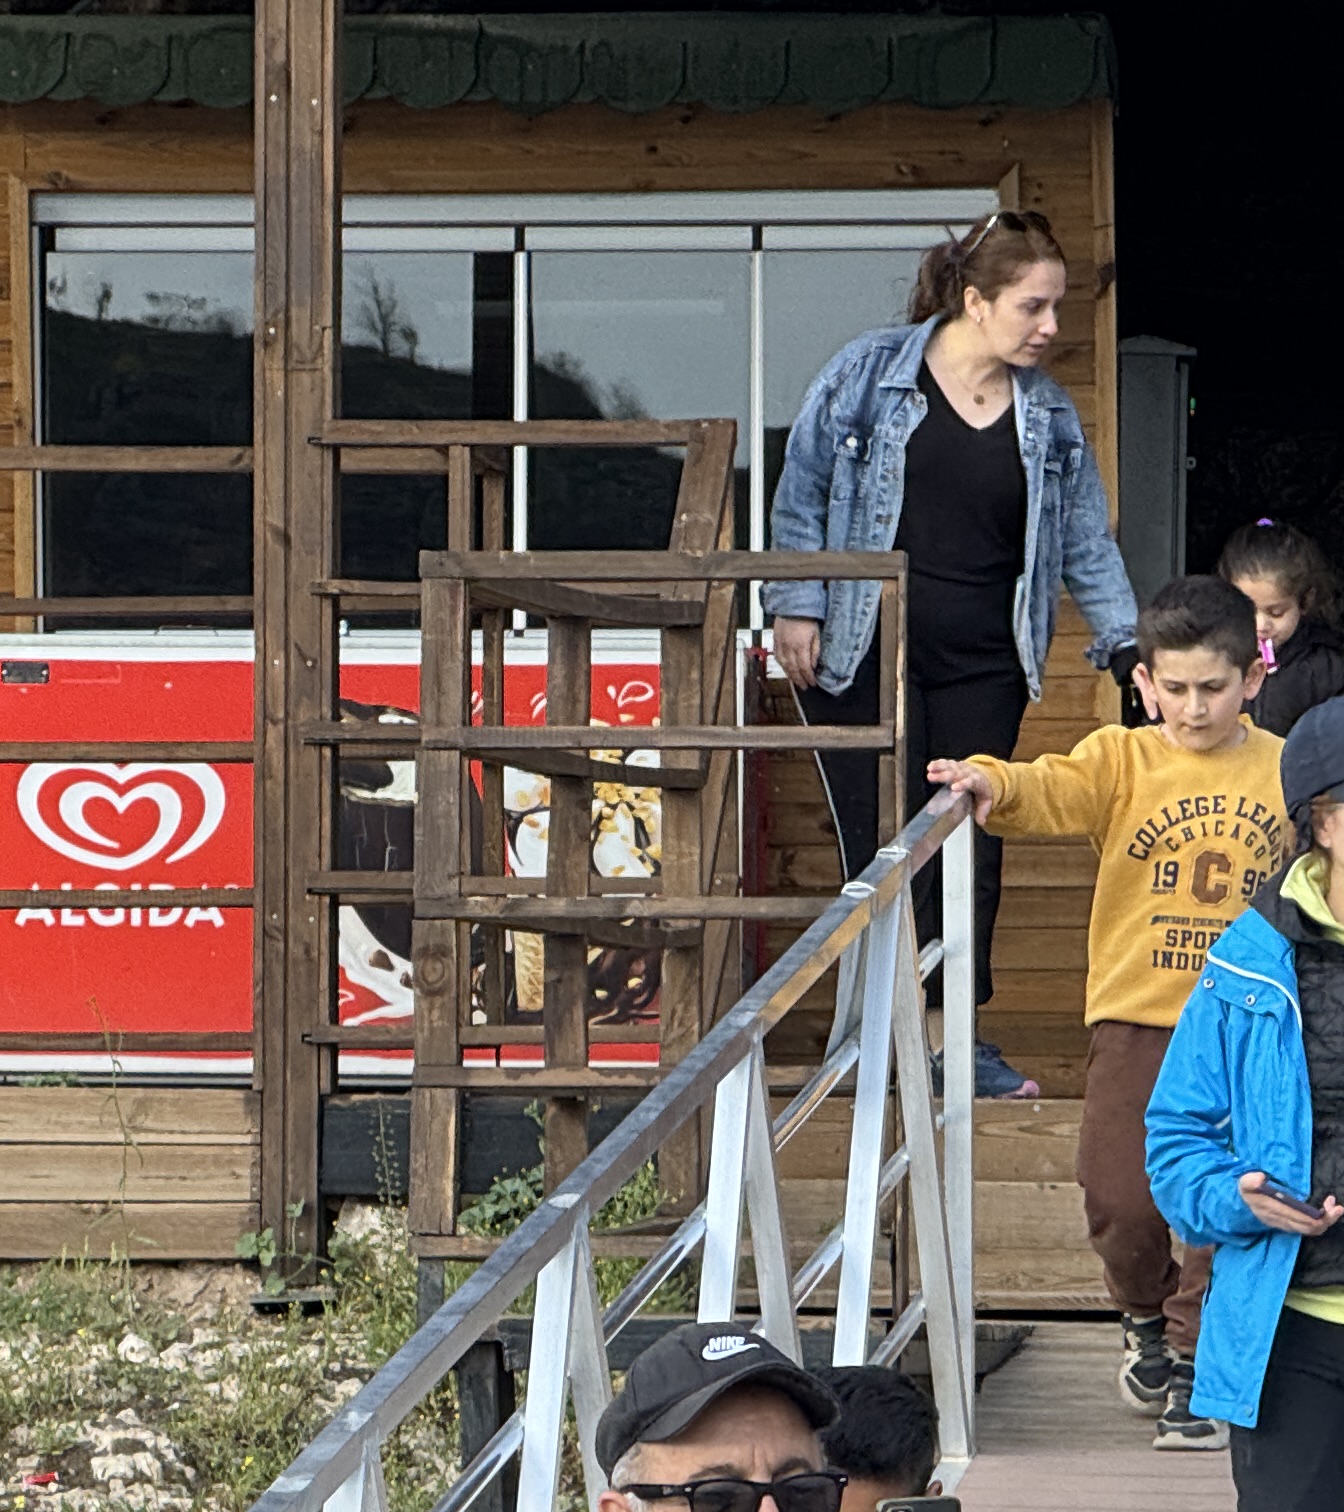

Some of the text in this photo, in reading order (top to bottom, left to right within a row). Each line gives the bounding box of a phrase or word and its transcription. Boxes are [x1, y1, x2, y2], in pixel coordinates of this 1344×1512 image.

[1127, 794, 1227, 861] COLLEGE
[1164, 820, 1267, 860] CHICAGO
[1152, 861, 1180, 888] 19
[1191, 850, 1233, 904] C
[15, 882, 225, 928] ALGIDA
[1152, 949, 1207, 971] INDU
[709, 1336, 745, 1352] NIKE
